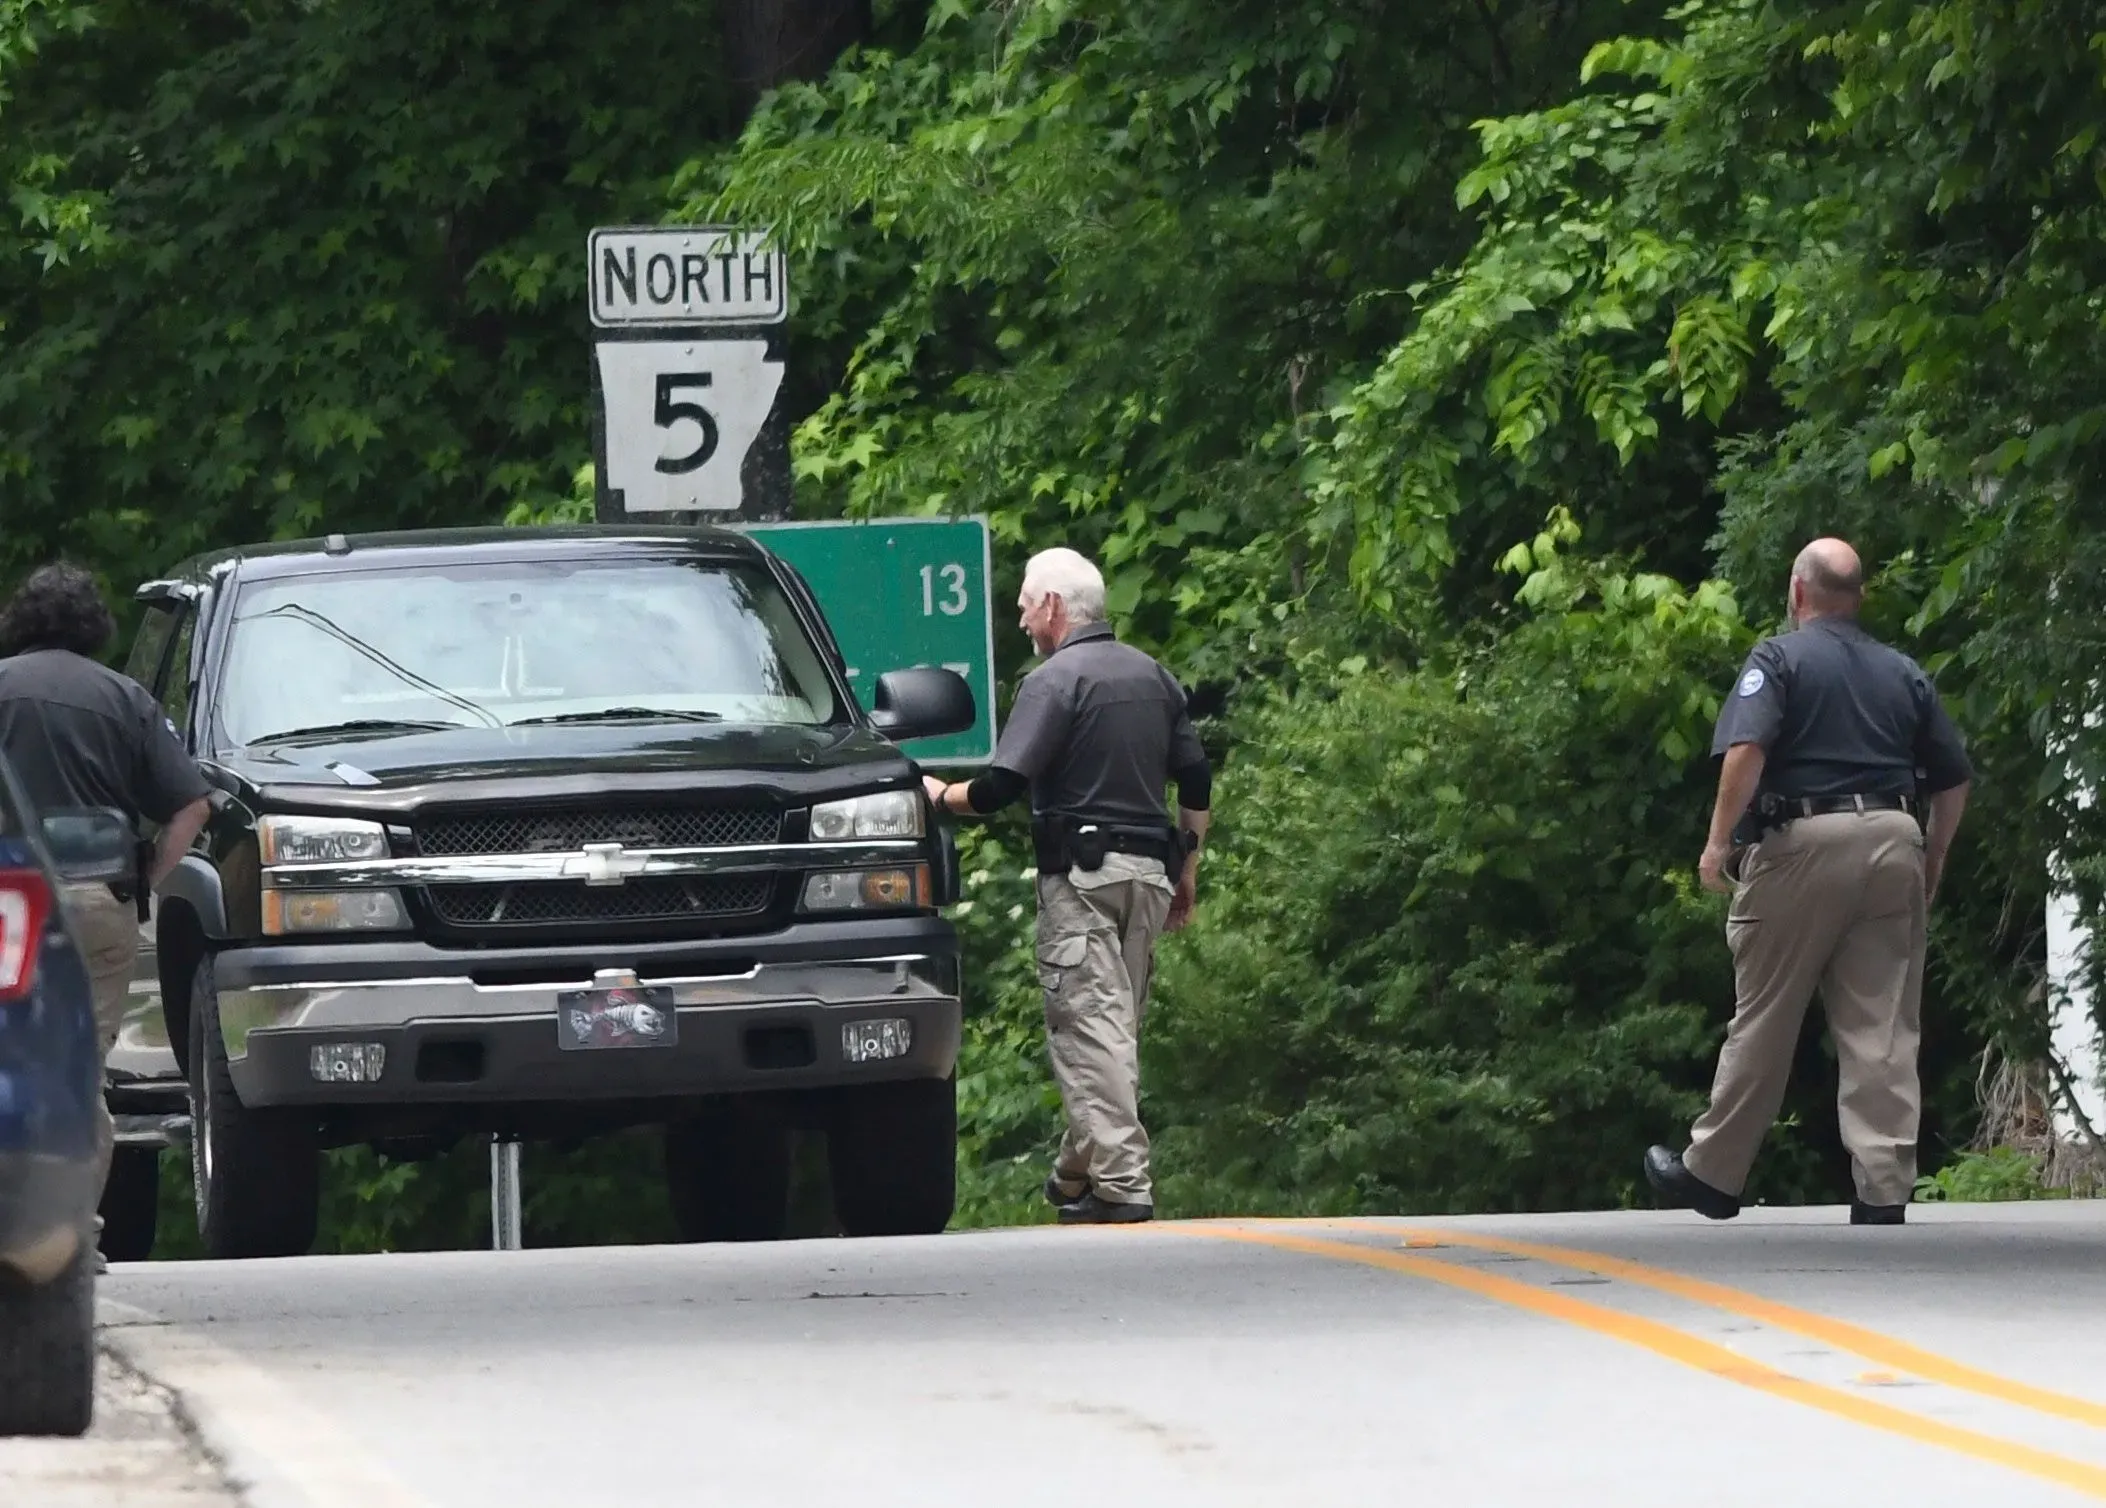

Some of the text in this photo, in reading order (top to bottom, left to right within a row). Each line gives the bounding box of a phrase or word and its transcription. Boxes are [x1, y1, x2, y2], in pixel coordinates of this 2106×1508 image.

[603, 246, 772, 306] NORTH
[654, 371, 719, 475] 5
[919, 563, 968, 617] 13
